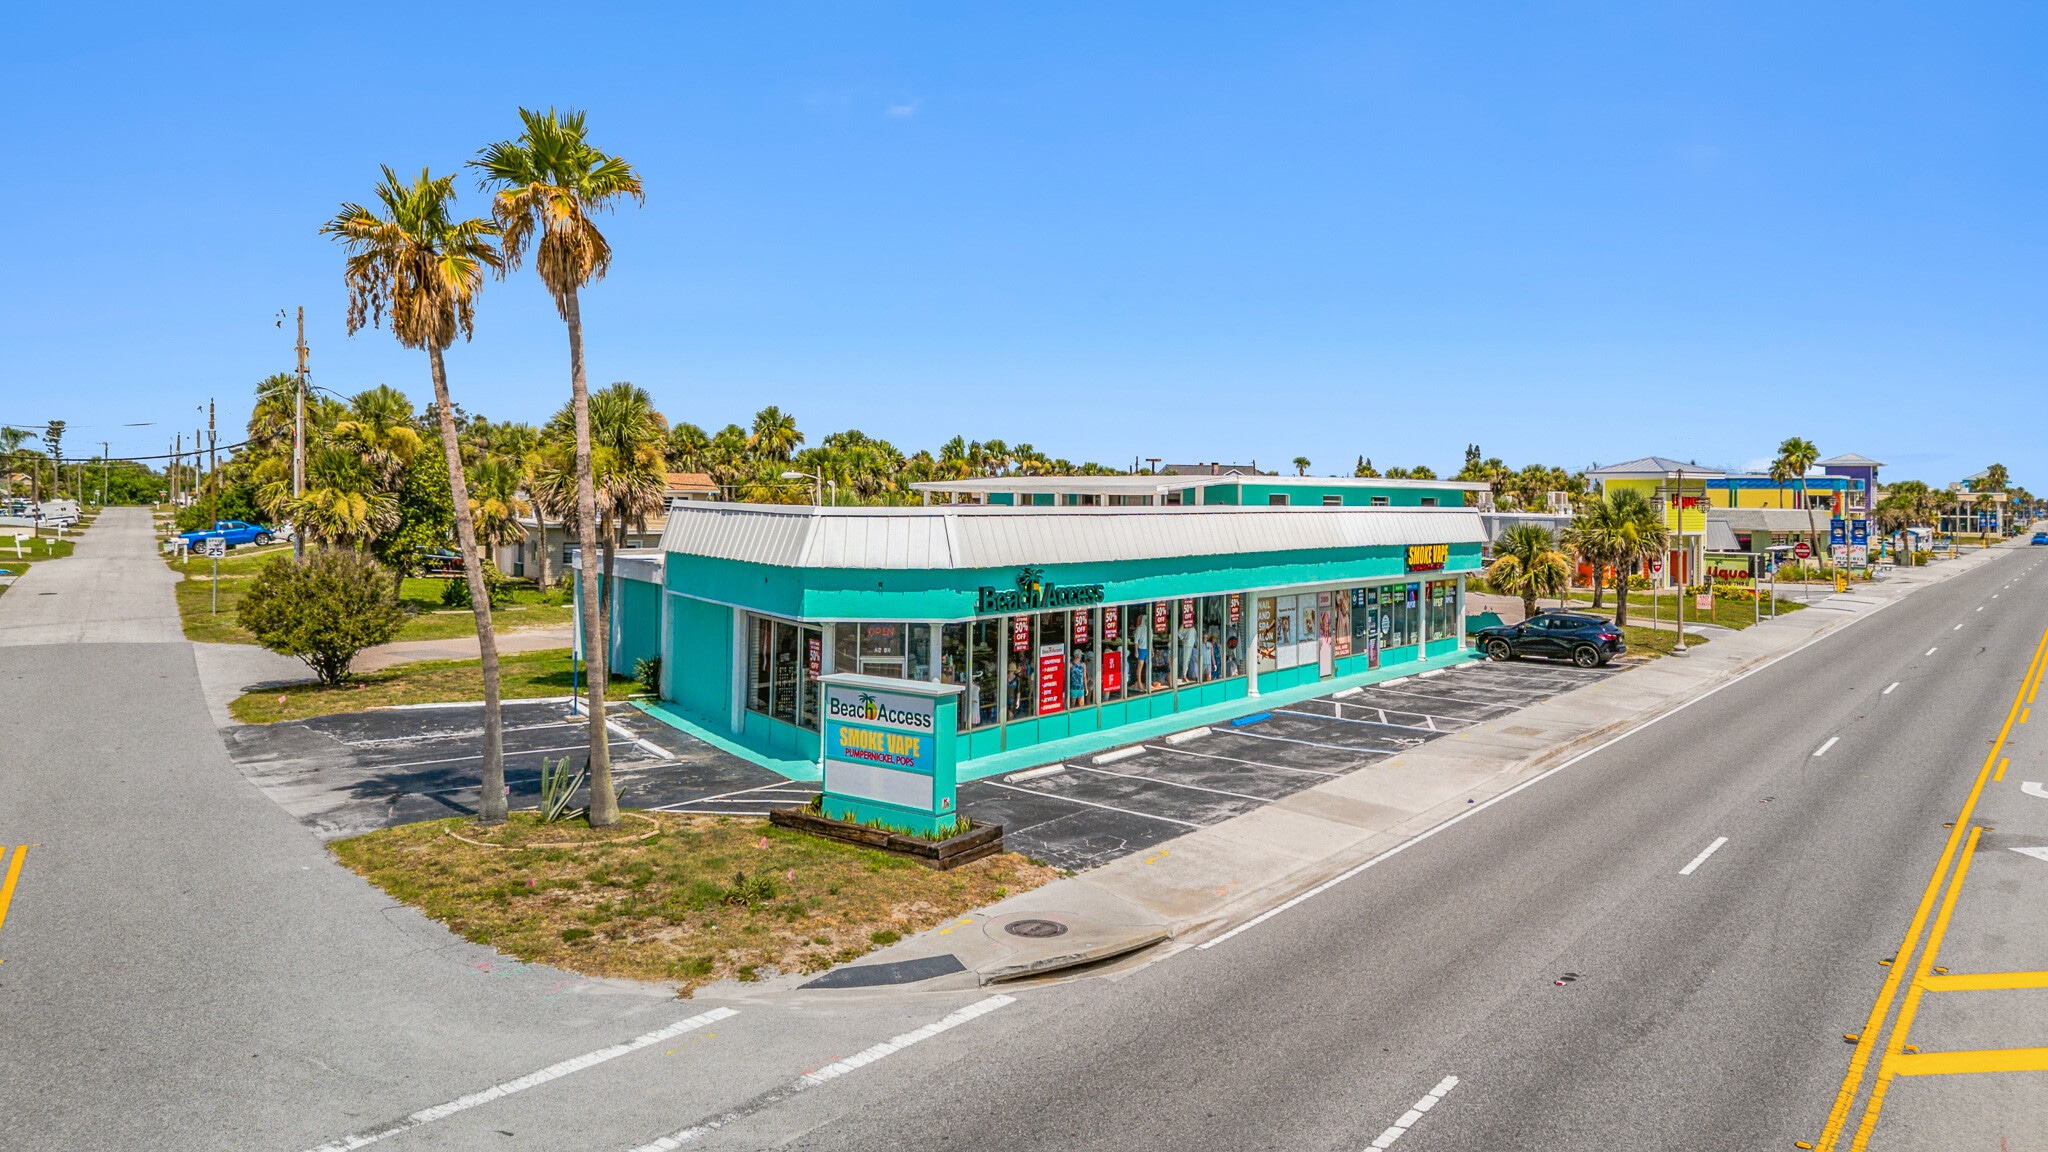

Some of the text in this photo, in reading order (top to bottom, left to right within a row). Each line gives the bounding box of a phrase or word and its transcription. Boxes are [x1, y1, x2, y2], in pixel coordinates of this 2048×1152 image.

[208, 548, 223, 556] 25
[1408, 544, 1449, 565] SMOKE VAPE
[979, 581, 1105, 613] Beach Access
[1183, 604, 1193, 613] 50%
[1258, 600, 1271, 609] NAIL
[1106, 612, 1117, 622] 50%
[1156, 607, 1166, 617] 50%
[1258, 611, 1271, 620] AND
[1075, 616, 1088, 627] 50%
[1258, 621, 1270, 631] SPA
[868, 626, 895, 637] OPEN
[1015, 622, 1028, 633] 50%
[810, 650, 820, 661] 50%
[830, 697, 932, 728] Beach Access
[840, 727, 920, 758] SMOKE VAPE
[845, 747, 915, 767] PUMPERNICKEL POPS
